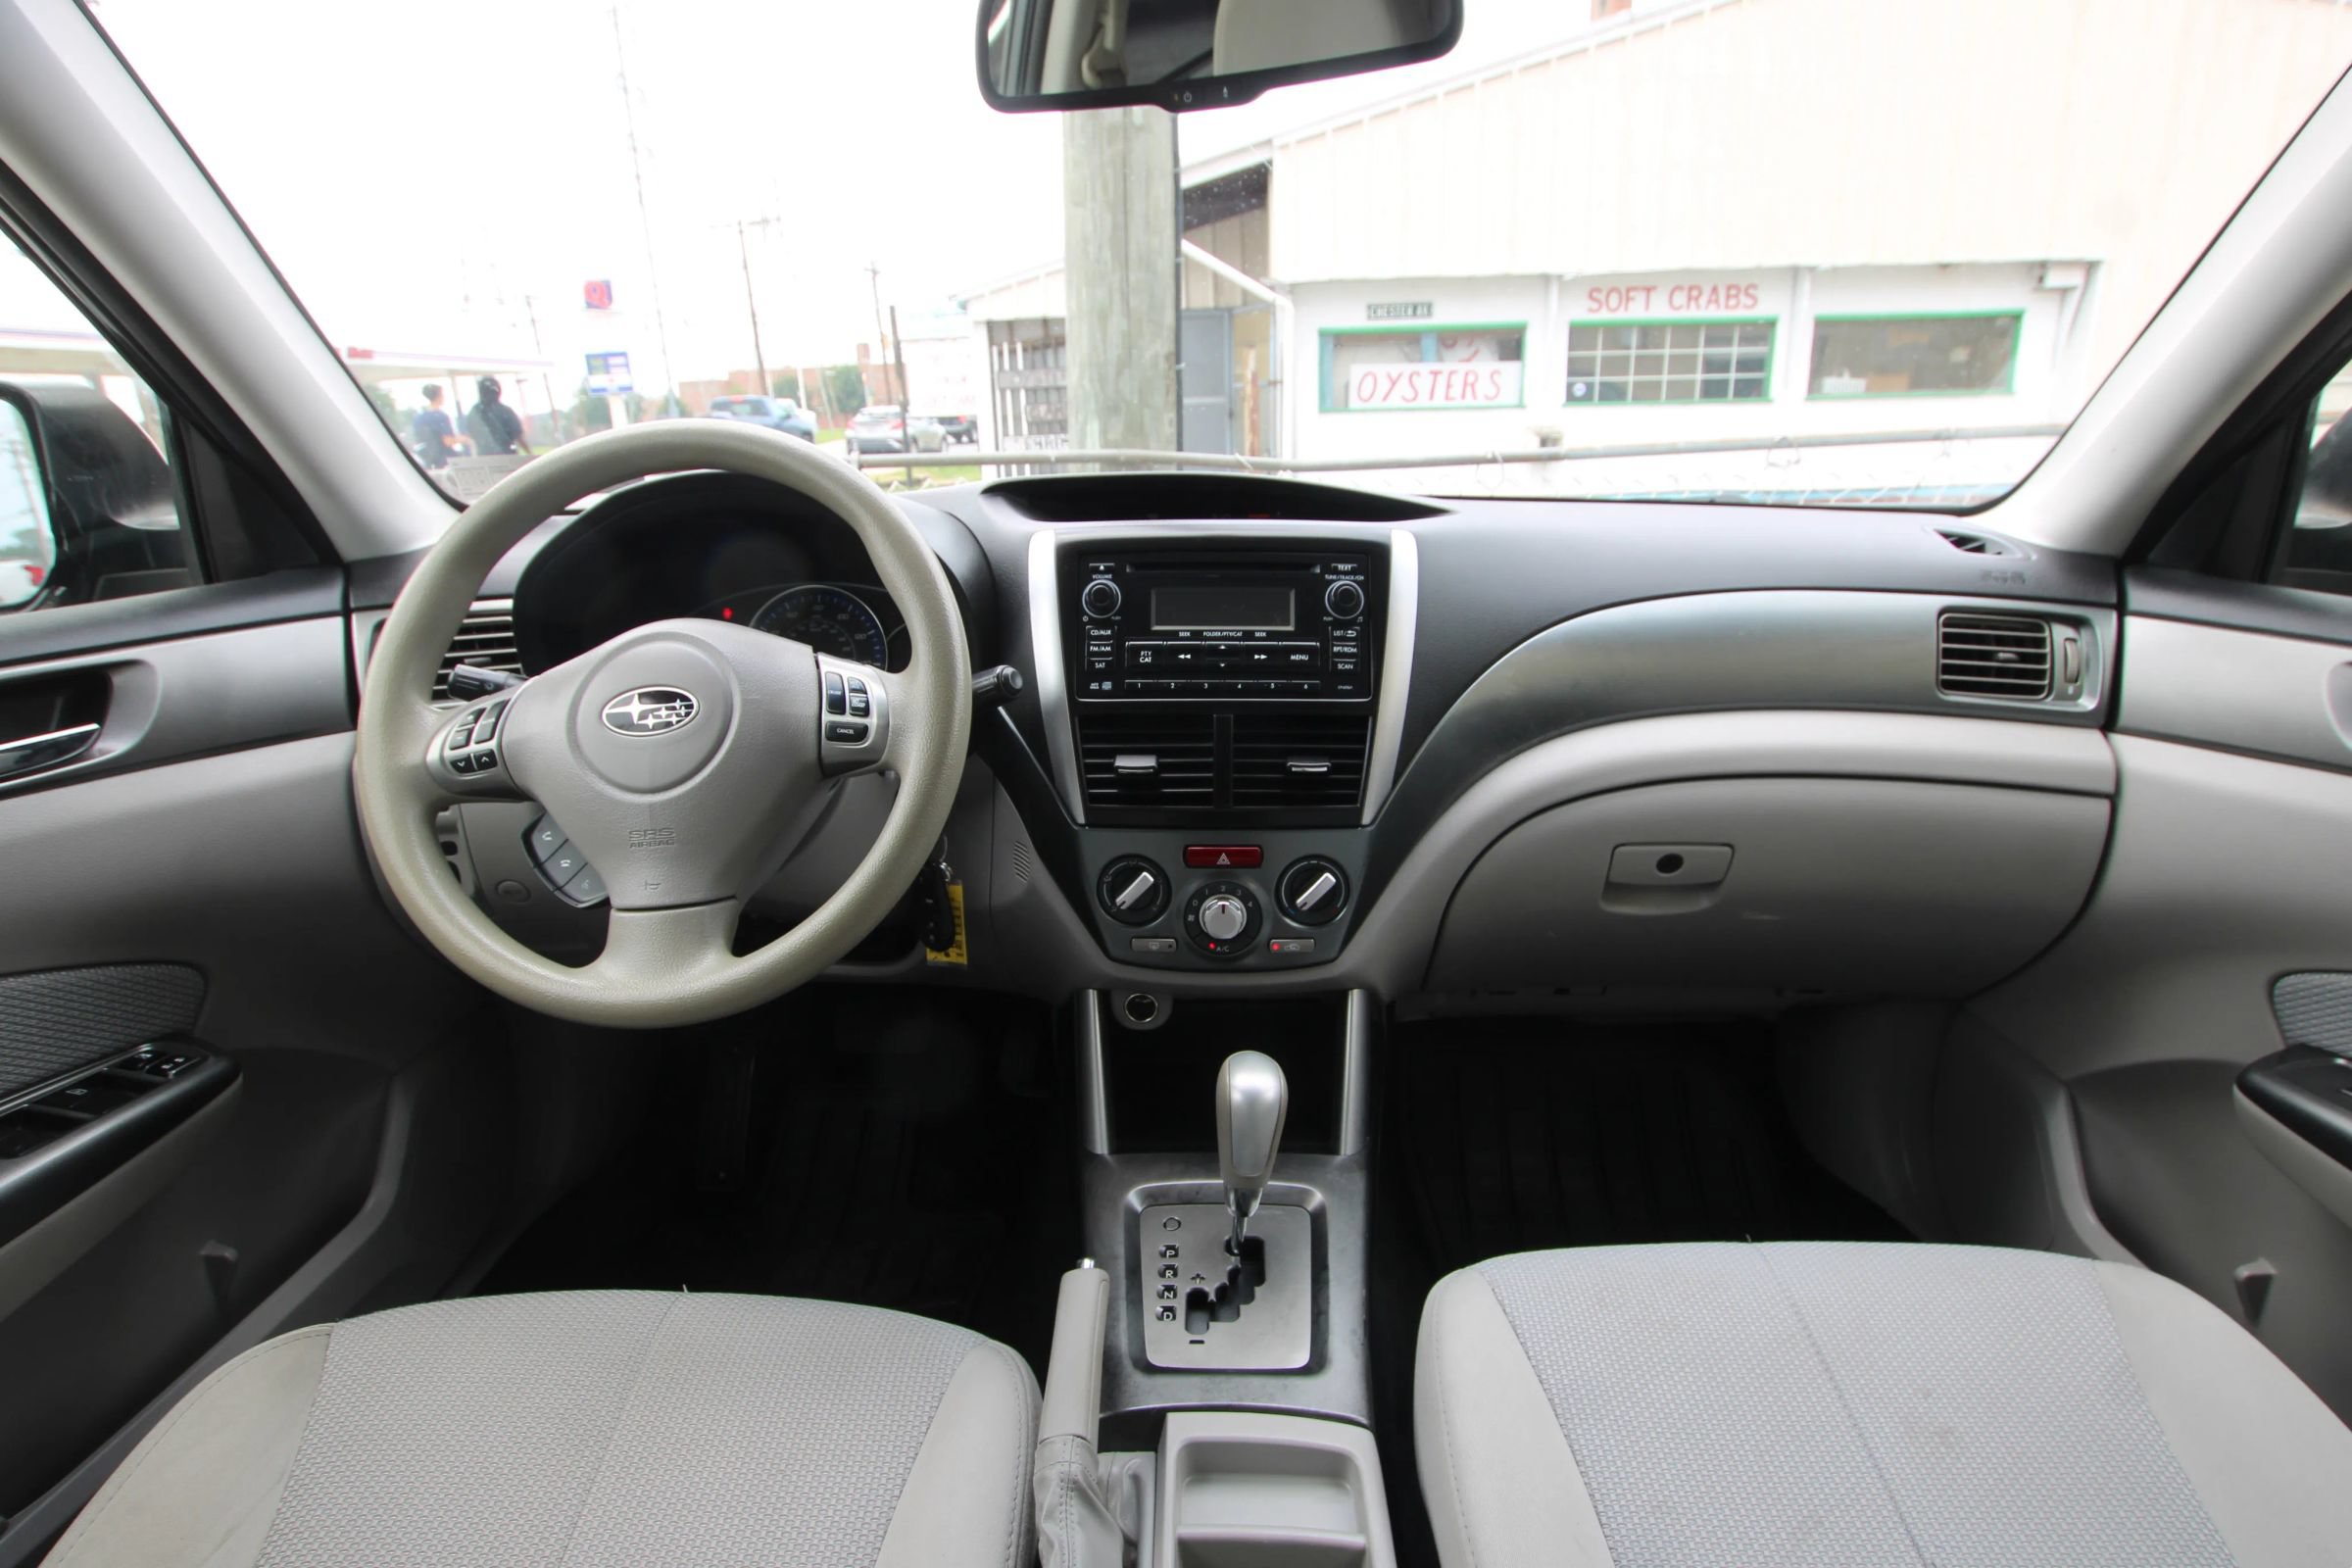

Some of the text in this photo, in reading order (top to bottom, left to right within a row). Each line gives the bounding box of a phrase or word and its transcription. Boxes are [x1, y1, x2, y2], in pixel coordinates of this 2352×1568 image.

[1588, 283, 1759, 314] SOFT CRABS
[1357, 369, 1502, 403] OYSTERS
[628, 827, 675, 840] SRS
[629, 838, 675, 849] AIRBAG
[1166, 1250, 1175, 1258] P
[1165, 1270, 1174, 1279] R
[1164, 1291, 1174, 1299] N
[1163, 1312, 1173, 1321] D
